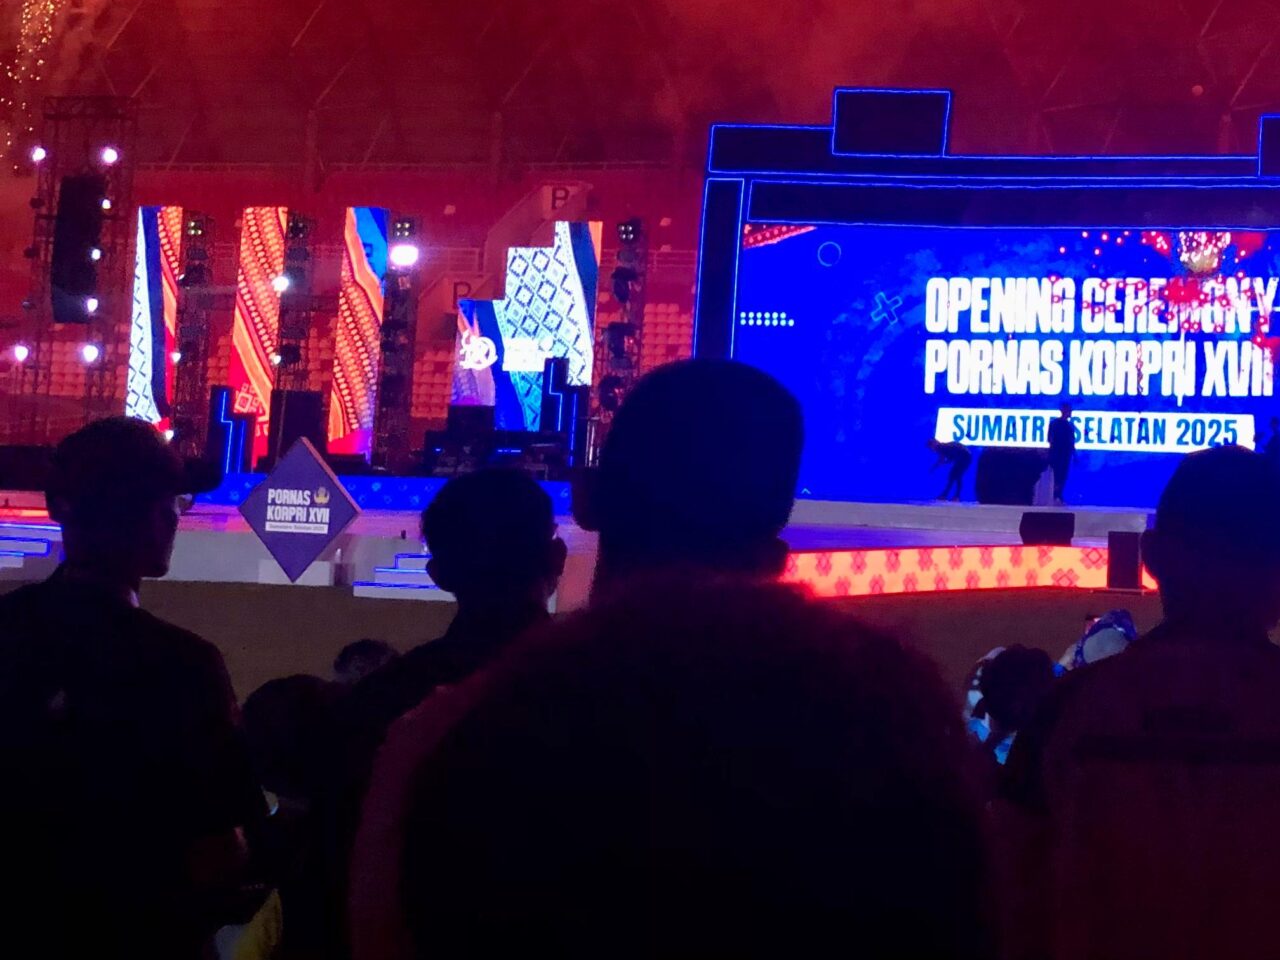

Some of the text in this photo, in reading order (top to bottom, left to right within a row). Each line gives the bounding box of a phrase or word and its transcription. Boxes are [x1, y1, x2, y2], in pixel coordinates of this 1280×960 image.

[552, 187, 569, 210] P
[925, 277, 1076, 333] OPENING
[924, 339, 1274, 397] PORNAS KORPRI XVII
[952, 414, 1238, 447] SUMATR SELATAN 2025
[267, 488, 311, 506] PORNAS
[266, 505, 330, 523] KORPRI XVII
